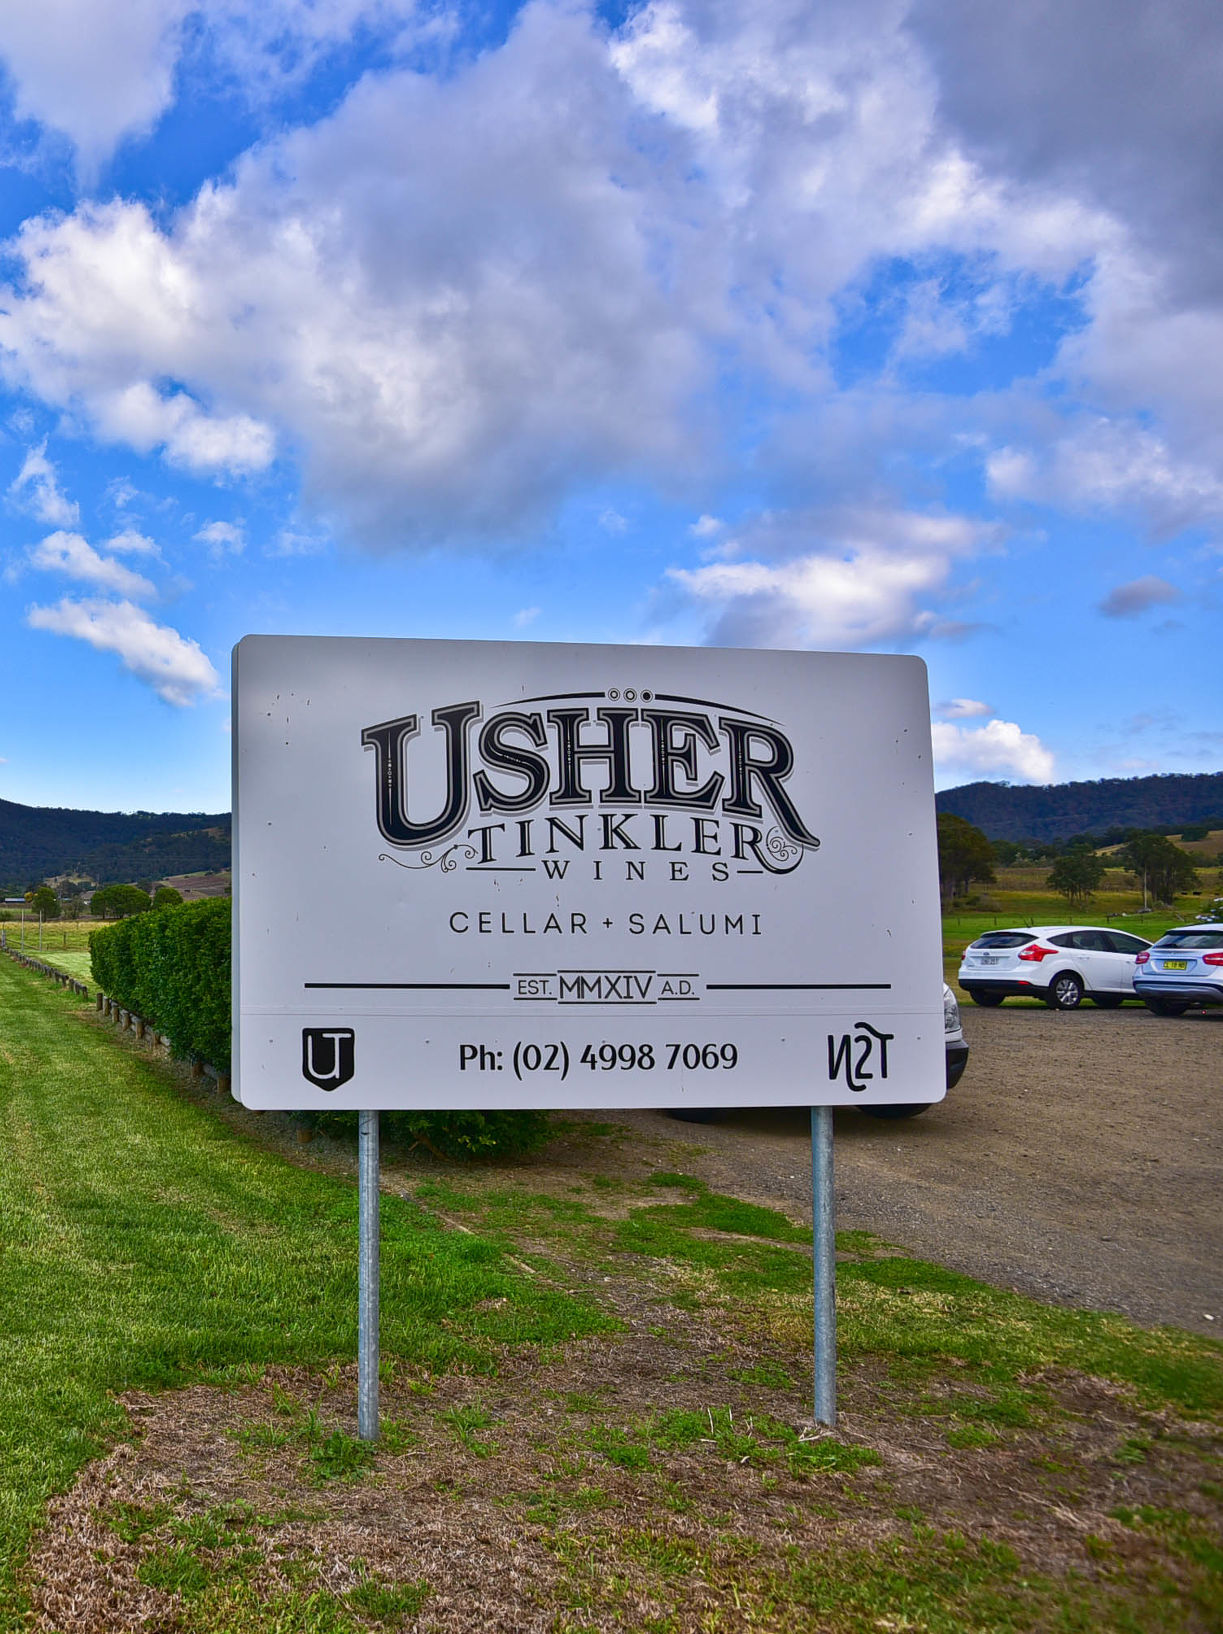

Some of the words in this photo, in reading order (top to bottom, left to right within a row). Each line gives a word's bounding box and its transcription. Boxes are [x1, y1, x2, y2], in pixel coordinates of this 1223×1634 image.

[361, 701, 821, 850] USHER
[468, 813, 764, 864] TINKLER
[541, 860, 730, 882] WINES
[449, 911, 588, 935] CELLAR
[628, 913, 763, 936] SALUMI
[517, 979, 553, 996] EST.
[559, 975, 653, 1000] MMXIV
[661, 980, 695, 996] A.D.
[459, 1044, 503, 1071] Ph:
[513, 1041, 570, 1081] (02)
[580, 1043, 655, 1071] 4998
[665, 1043, 739, 1071] 7069
